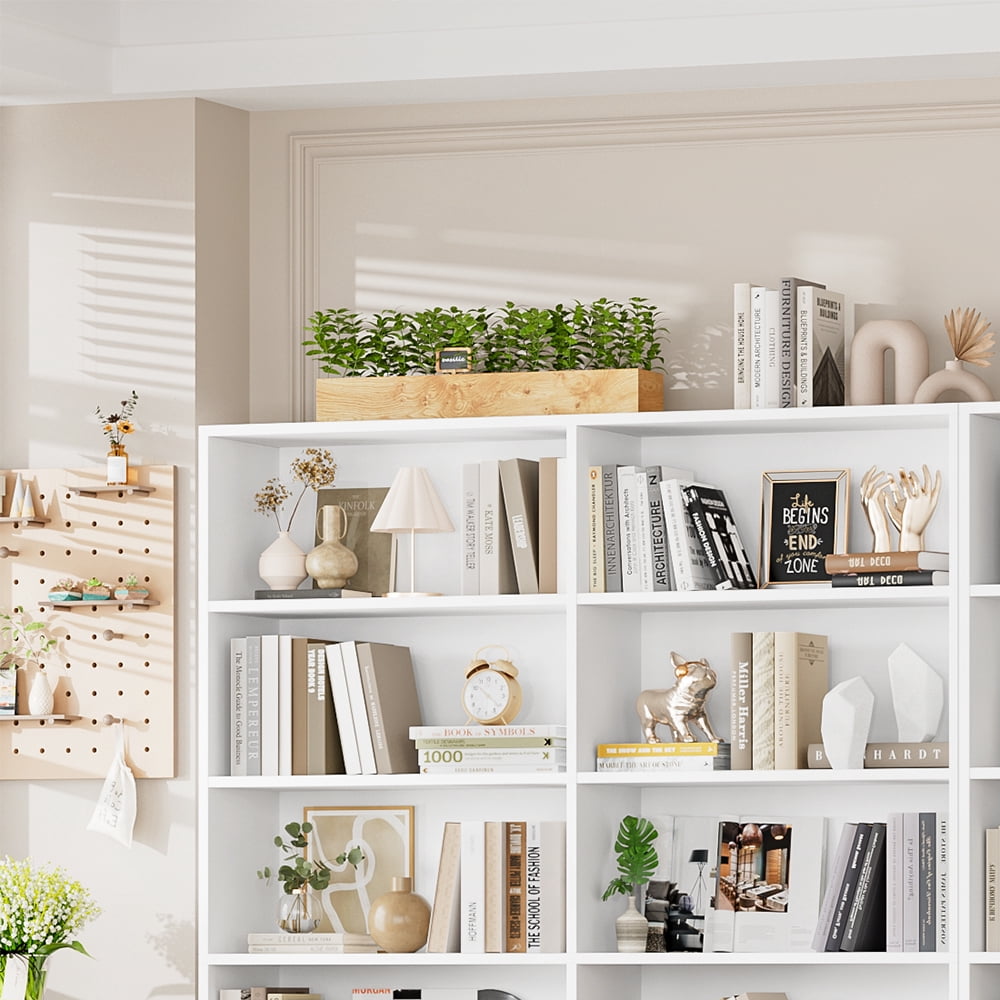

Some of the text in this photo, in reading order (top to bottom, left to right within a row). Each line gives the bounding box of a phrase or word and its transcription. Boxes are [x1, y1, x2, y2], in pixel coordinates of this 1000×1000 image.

[782, 280, 791, 408] FURNITURE DESIGN
[800, 310, 808, 351] BLUEPRINTS
[800, 358, 808, 393] BUILDINGS
[484, 510, 493, 554] KATE MOSS
[782, 507, 829, 526] BEGINS
[653, 500, 666, 585] ARCHITECTURE
[788, 534, 818, 550] END
[784, 557, 819, 574] ZONE
[248, 668, 259, 759] LEMPEREUR
[738, 662, 749, 750] Miller Harris
[484, 728, 535, 736] SYMBOLS
[423, 750, 463, 763] 1000
[528, 847, 540, 948] THE SCHOOL OF FASHION
[468, 902, 477, 941] HOFFMANN
